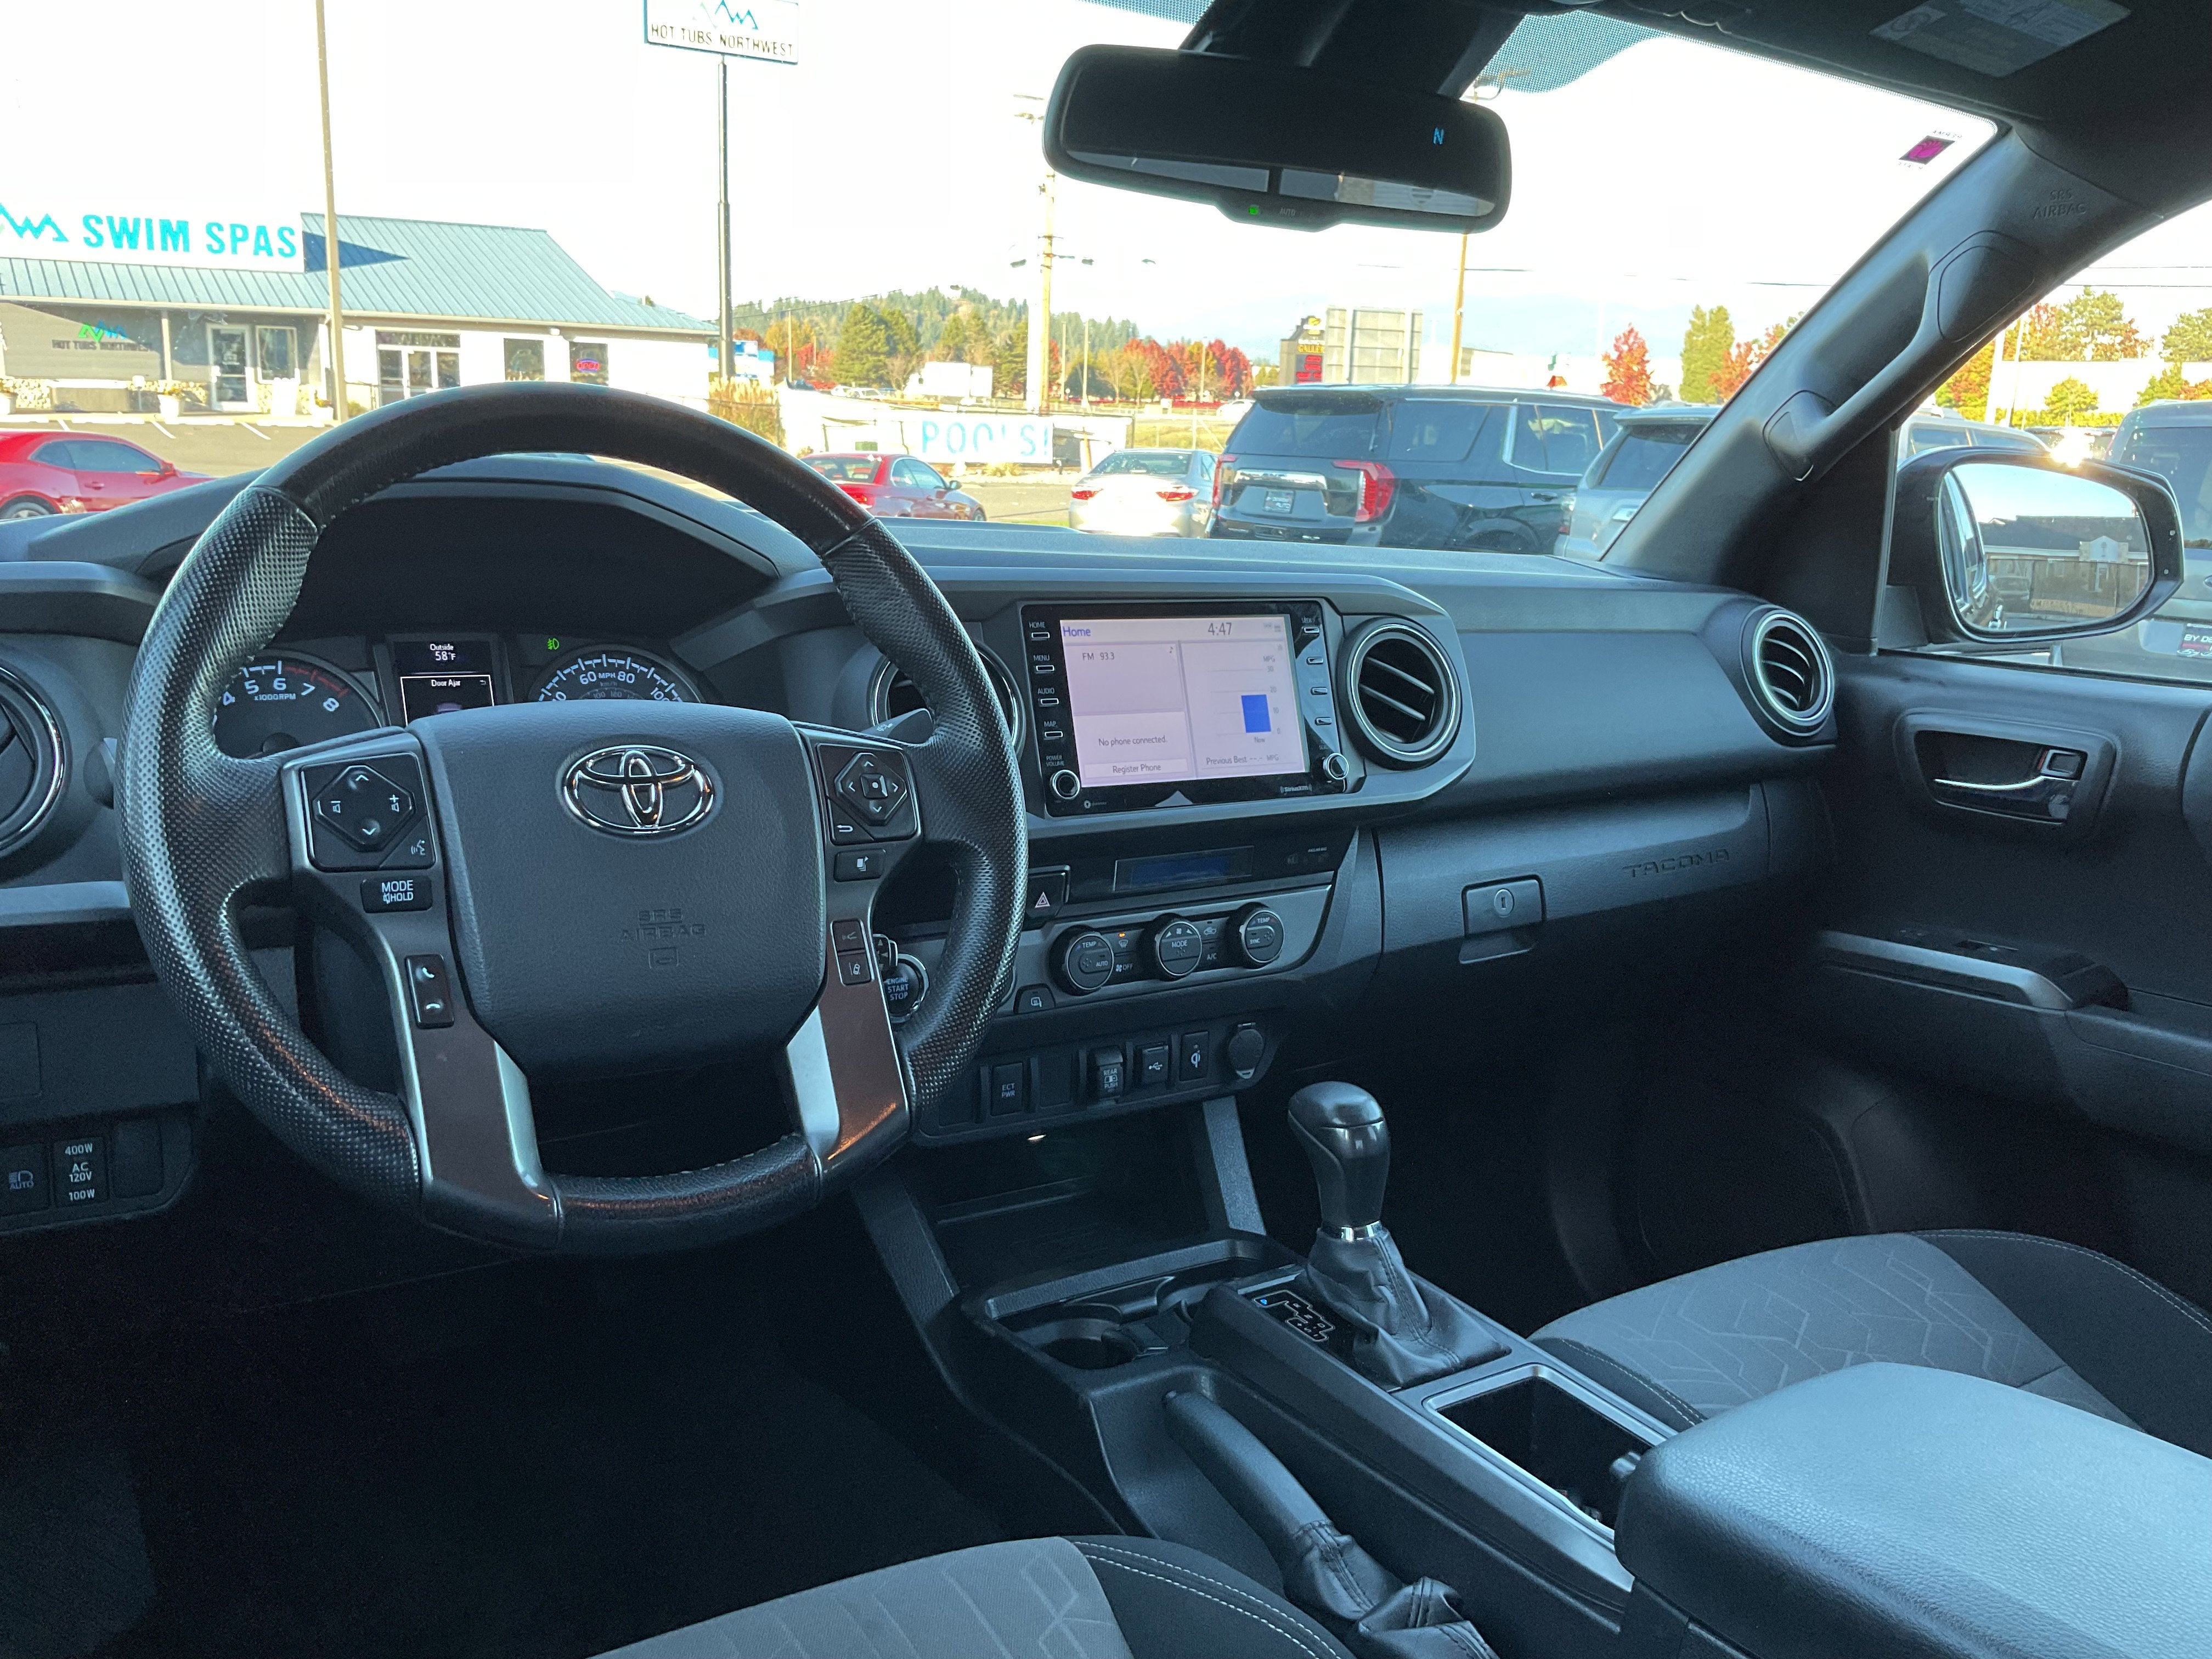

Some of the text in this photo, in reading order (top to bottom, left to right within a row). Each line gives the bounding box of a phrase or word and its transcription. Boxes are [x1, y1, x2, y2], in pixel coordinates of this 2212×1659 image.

[651, 24, 793, 57] HOT TUBS NORTHWEST
[1432, 127, 1445, 145] N
[1279, 207, 1296, 216] AUTO
[82, 215, 296, 258] SWIM SPAS
[576, 362, 600, 370] OPEN
[1063, 626, 1092, 637] Home
[1207, 622, 1233, 636] 4:47
[430, 643, 454, 651] Outside
[435, 651, 456, 661] 58°F
[1082, 652, 1115, 661] FM 93.3
[448, 679, 461, 687] Ajar
[579, 670, 597, 685] 60
[617, 670, 635, 684] 80
[244, 679, 259, 695] 5
[274, 678, 287, 691] 6
[301, 682, 316, 696] 7
[323, 697, 340, 712] 8
[1098, 735, 1168, 747] No phone connected.
[1206, 756, 1233, 765] Previous
[1112, 763, 1161, 775] Register Phone
[1622, 849, 1729, 878] TACOMA
[381, 879, 414, 893] MODE
[390, 891, 414, 902] HOLD
[637, 908, 684, 922] SRS
[621, 924, 707, 943] AIRBAG
[1171, 940, 1188, 948] MODE
[1207, 952, 1217, 961] A/C
[887, 977, 909, 985] ENGINE
[888, 984, 909, 994] START
[890, 991, 909, 1001] STOP
[1002, 1083, 1015, 1091] ECT
[1001, 1090, 1015, 1098] PWR
[65, 1142, 93, 1156] 400W
[72, 1161, 89, 1173] AC
[69, 1171, 93, 1183] 120V
[9, 1180, 35, 1190] AUTO
[68, 1188, 95, 1201] 100W
